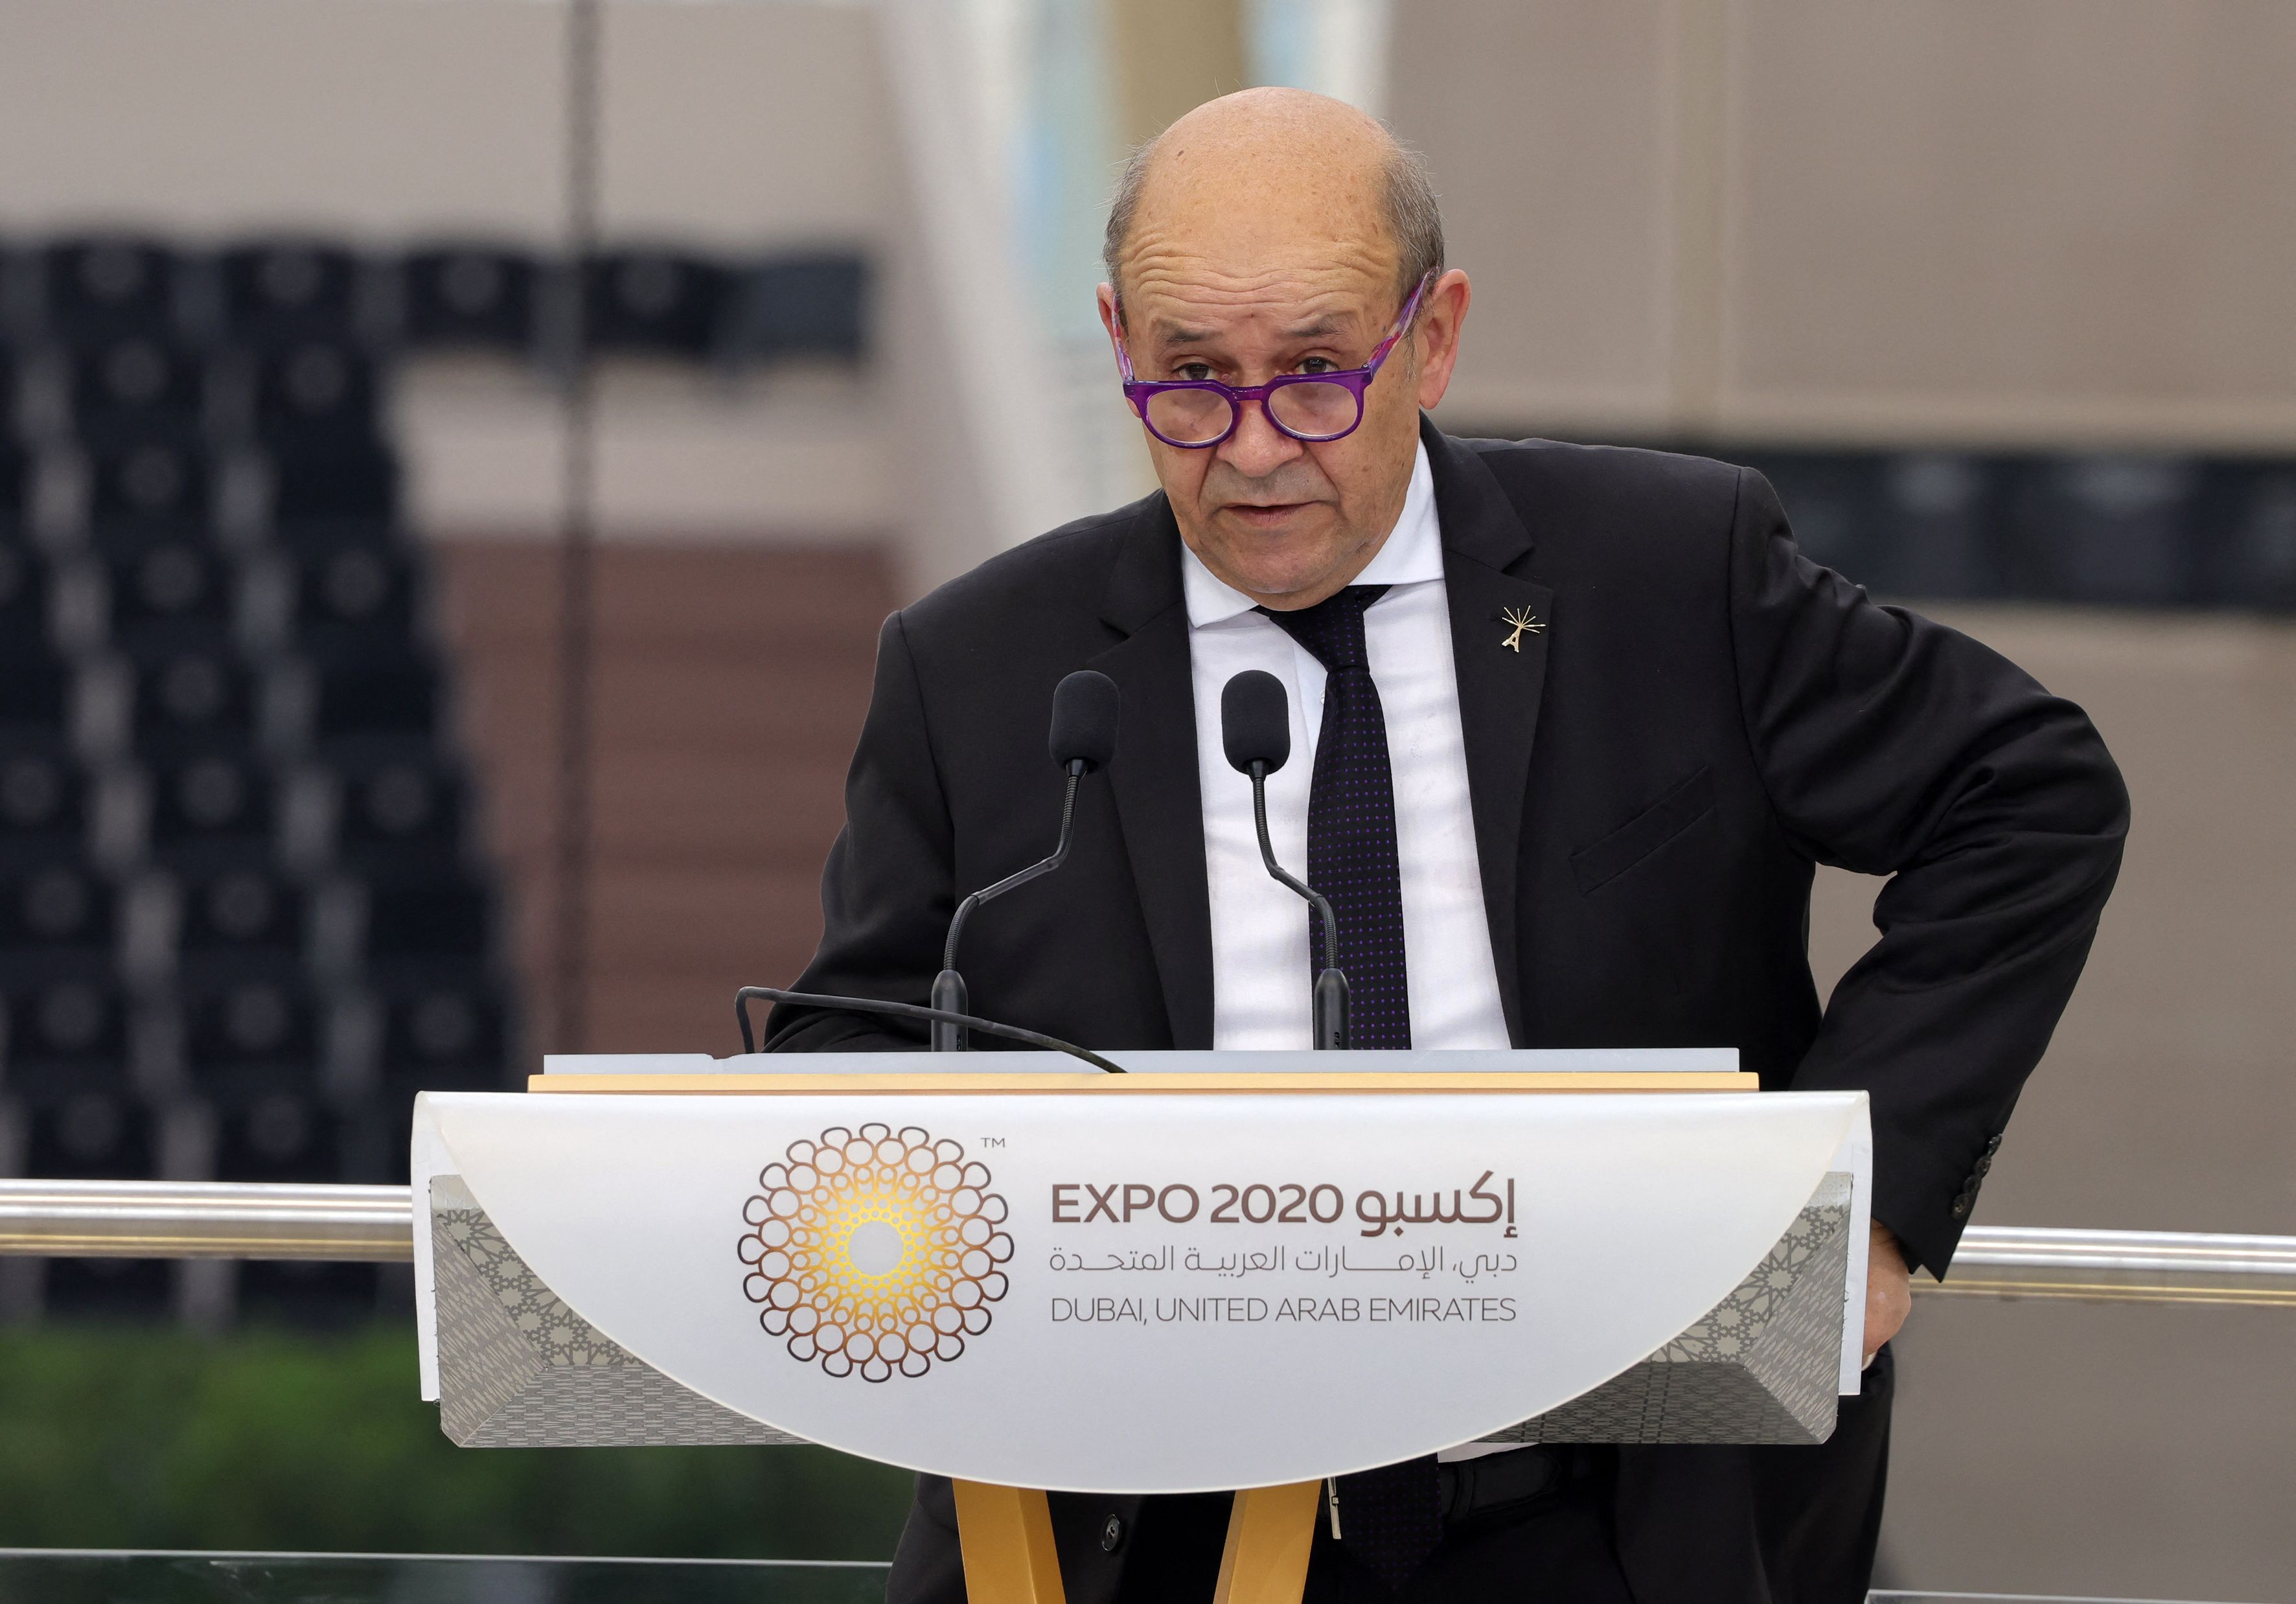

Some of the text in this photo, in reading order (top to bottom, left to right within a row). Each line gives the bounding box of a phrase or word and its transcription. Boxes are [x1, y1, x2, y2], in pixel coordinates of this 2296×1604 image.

[1051, 1184, 1344, 1224] EXPO 2020
[1355, 1170, 1519, 1239] إكسبو
[1184, 1245, 1285, 1278] العربية
[1051, 1298, 1517, 1326] DUBAI, UNITED ARAB EMIRATES
